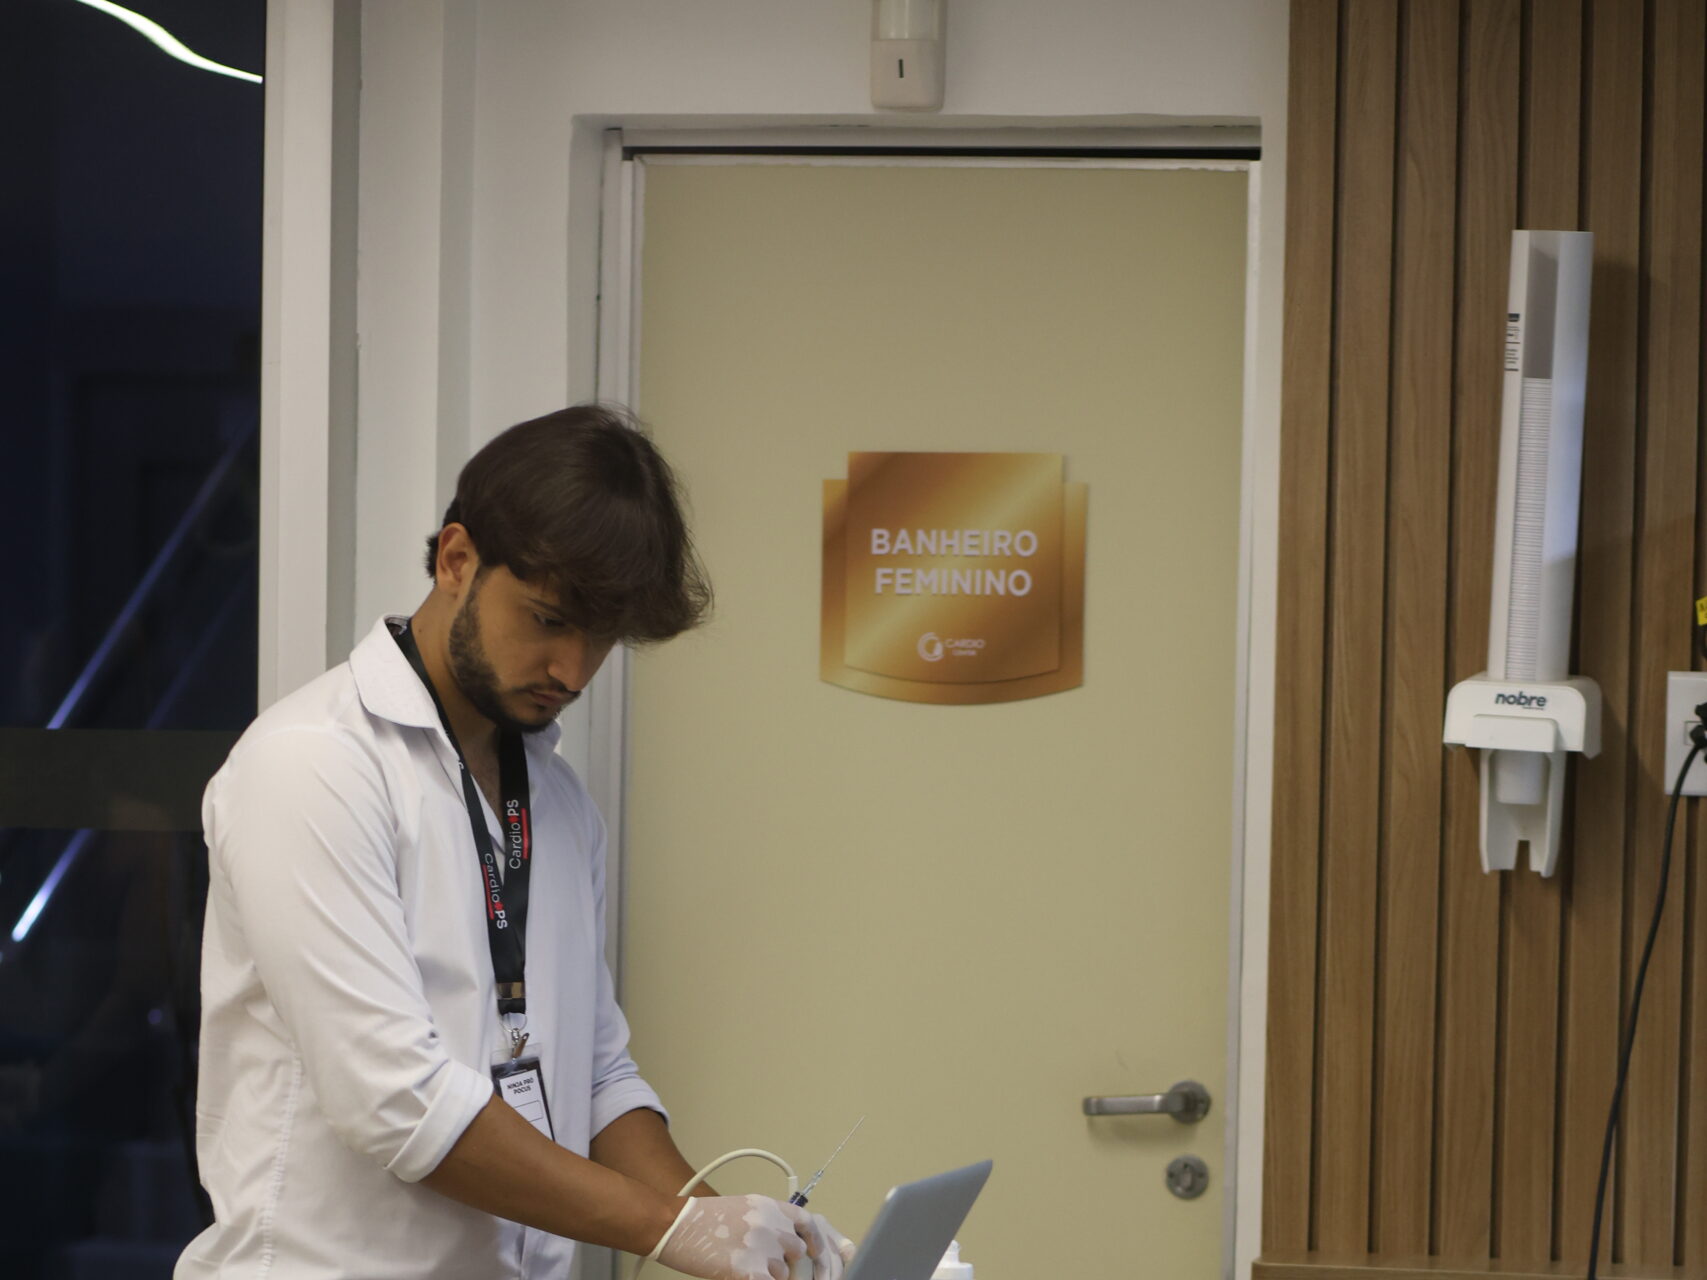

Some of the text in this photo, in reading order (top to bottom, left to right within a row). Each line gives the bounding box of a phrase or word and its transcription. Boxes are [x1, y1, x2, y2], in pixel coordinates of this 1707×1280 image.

[870, 528, 1038, 557] BANHEIRO
[875, 568, 1032, 596] FEMININO
[1495, 691, 1547, 707] nobre
